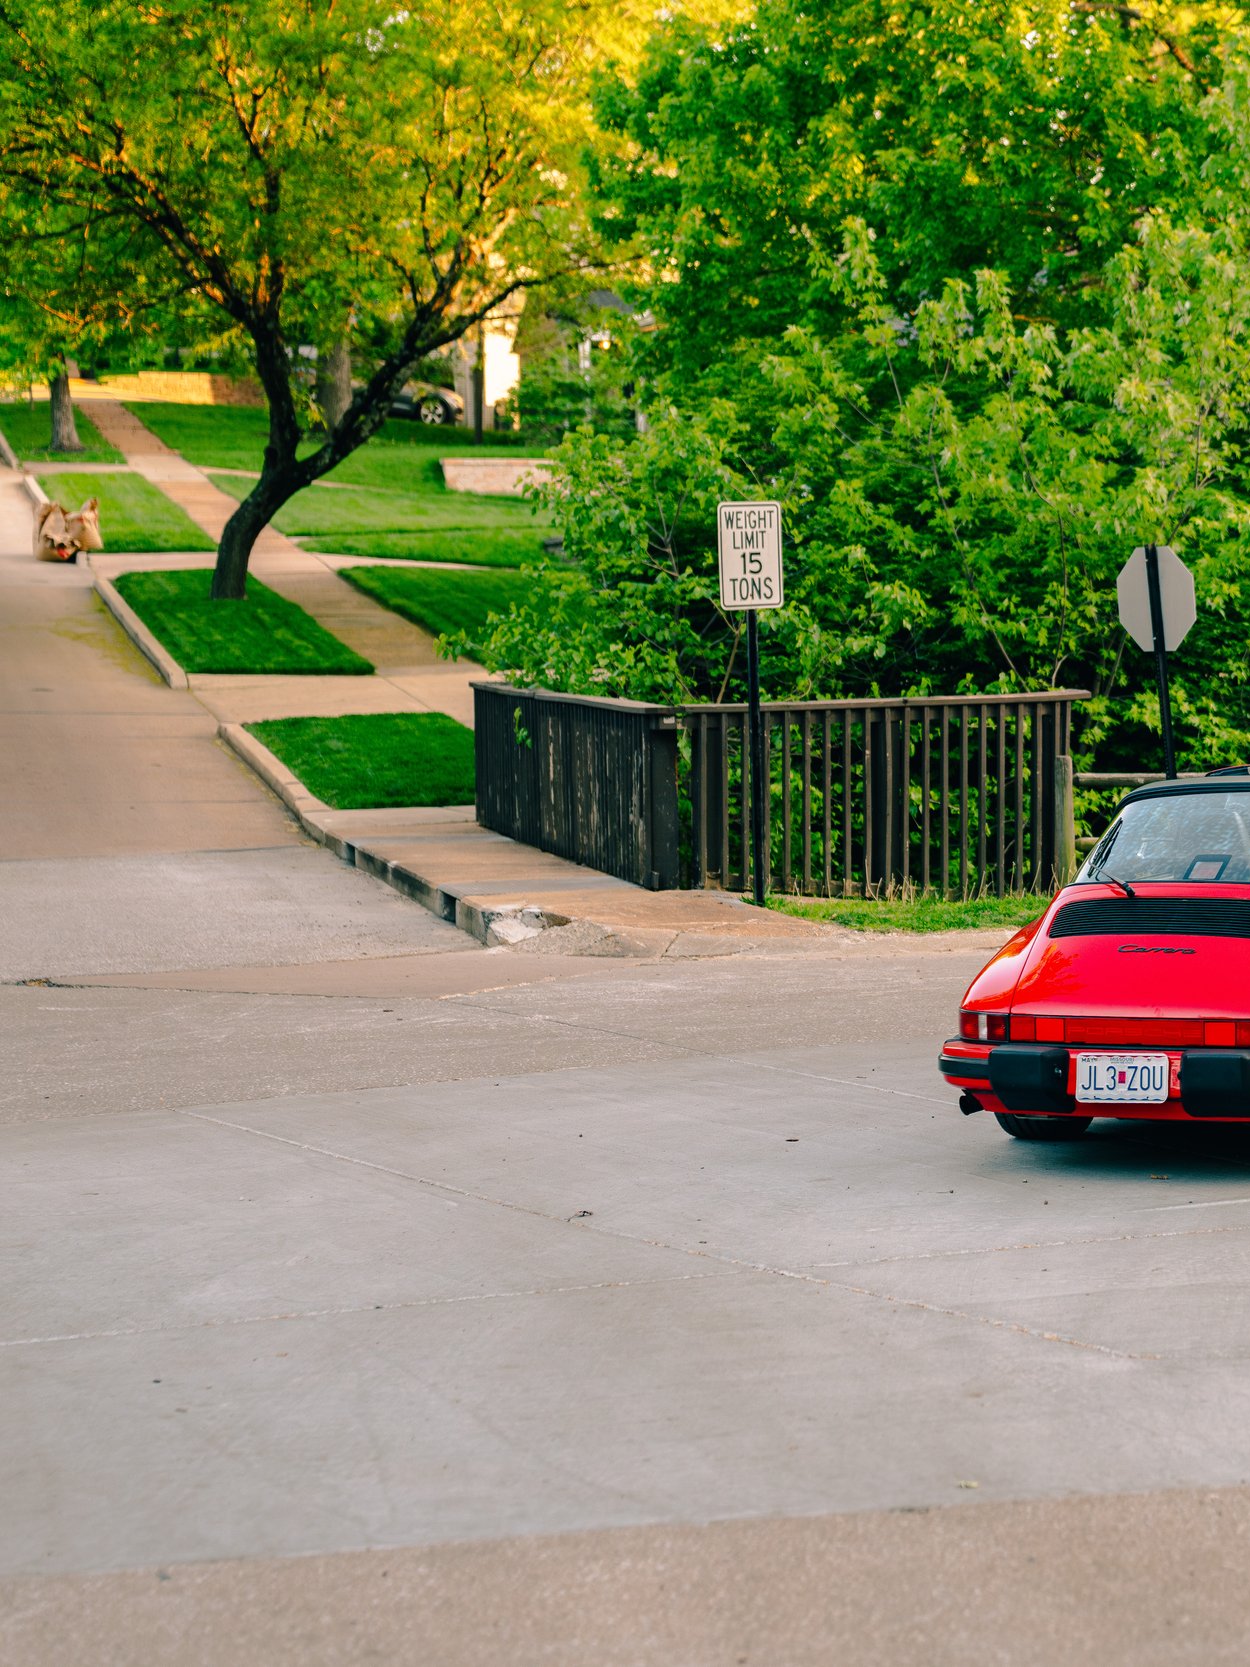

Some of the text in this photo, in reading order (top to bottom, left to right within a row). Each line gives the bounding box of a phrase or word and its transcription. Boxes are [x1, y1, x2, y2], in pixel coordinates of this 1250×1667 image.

[724, 510, 774, 529] WEIGHT
[732, 530, 766, 549] LIMIT
[740, 552, 763, 575] 15
[729, 576, 774, 601] TONS
[1118, 944, 1196, 954] Carrera
[1081, 1065, 1117, 1091] JL3
